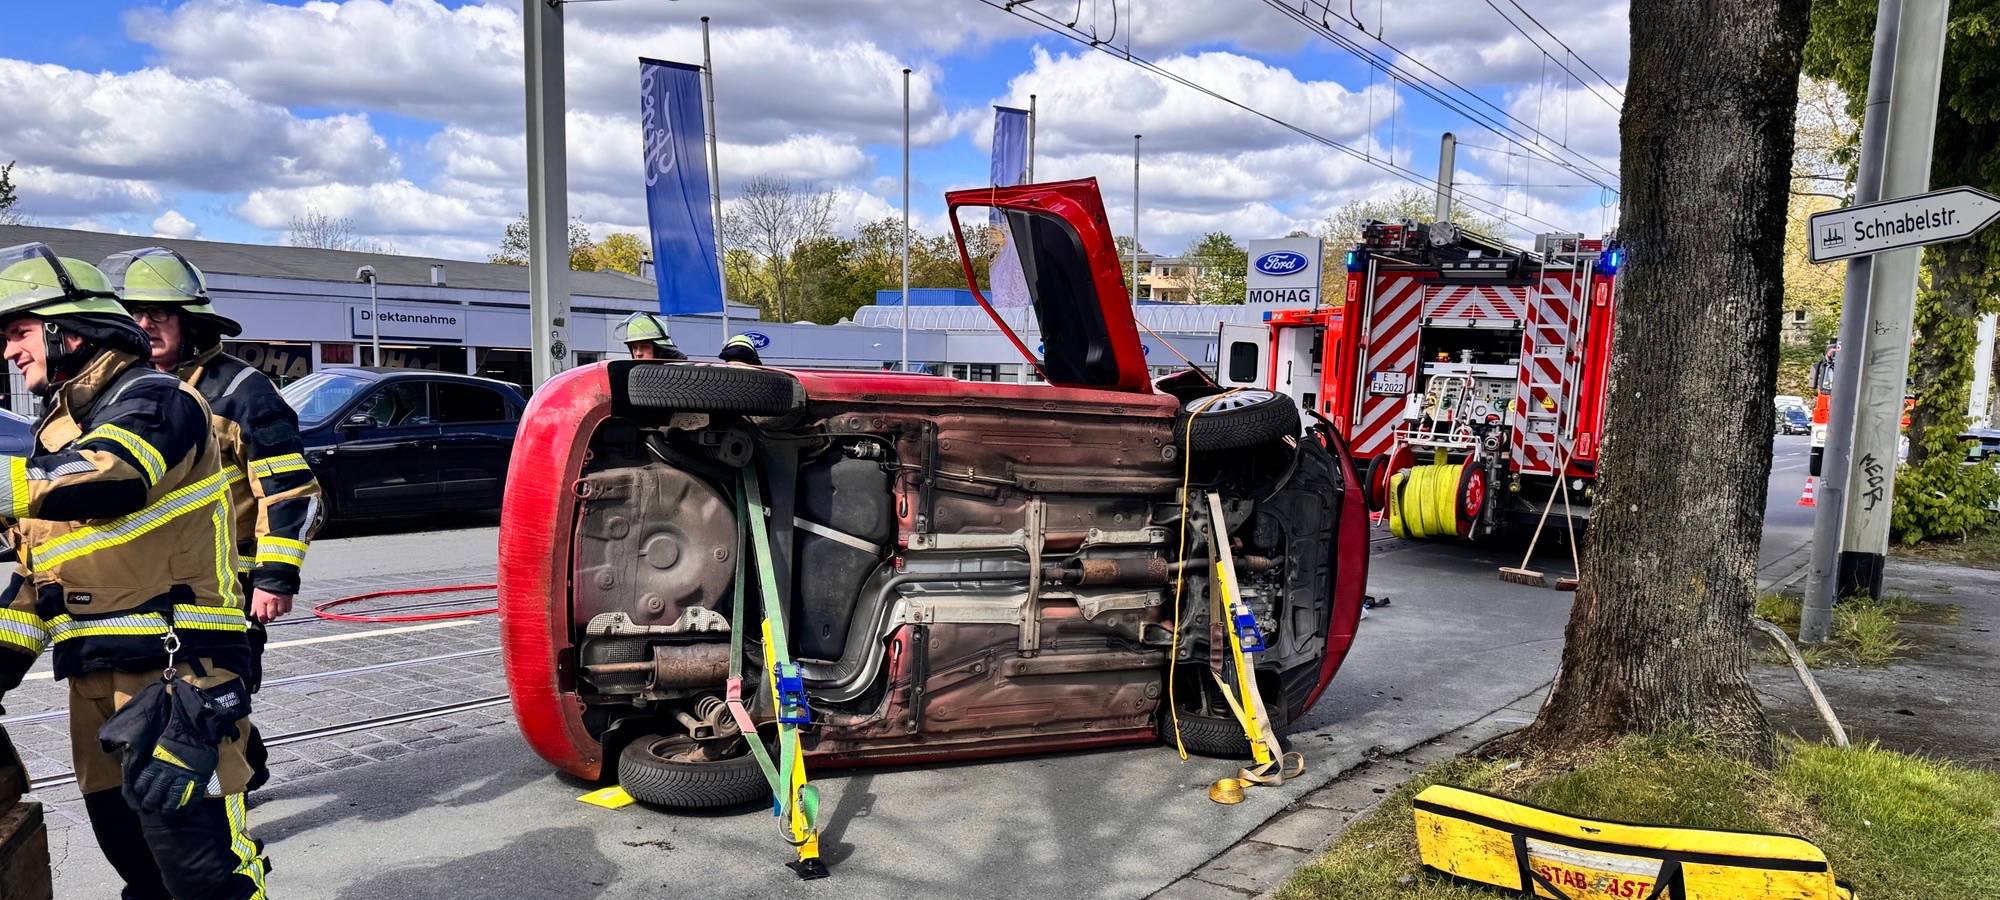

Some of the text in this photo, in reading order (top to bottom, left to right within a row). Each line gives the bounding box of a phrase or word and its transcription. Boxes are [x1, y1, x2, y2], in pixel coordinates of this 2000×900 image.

[1853, 207, 1960, 241] Schnabelstr.
[1263, 254, 1297, 271] Ford
[1249, 289, 1311, 303] MOHAG
[361, 310, 457, 325] Diektannahme
[1383, 373, 1389, 382] E
[1540, 864, 1587, 890] STAB
